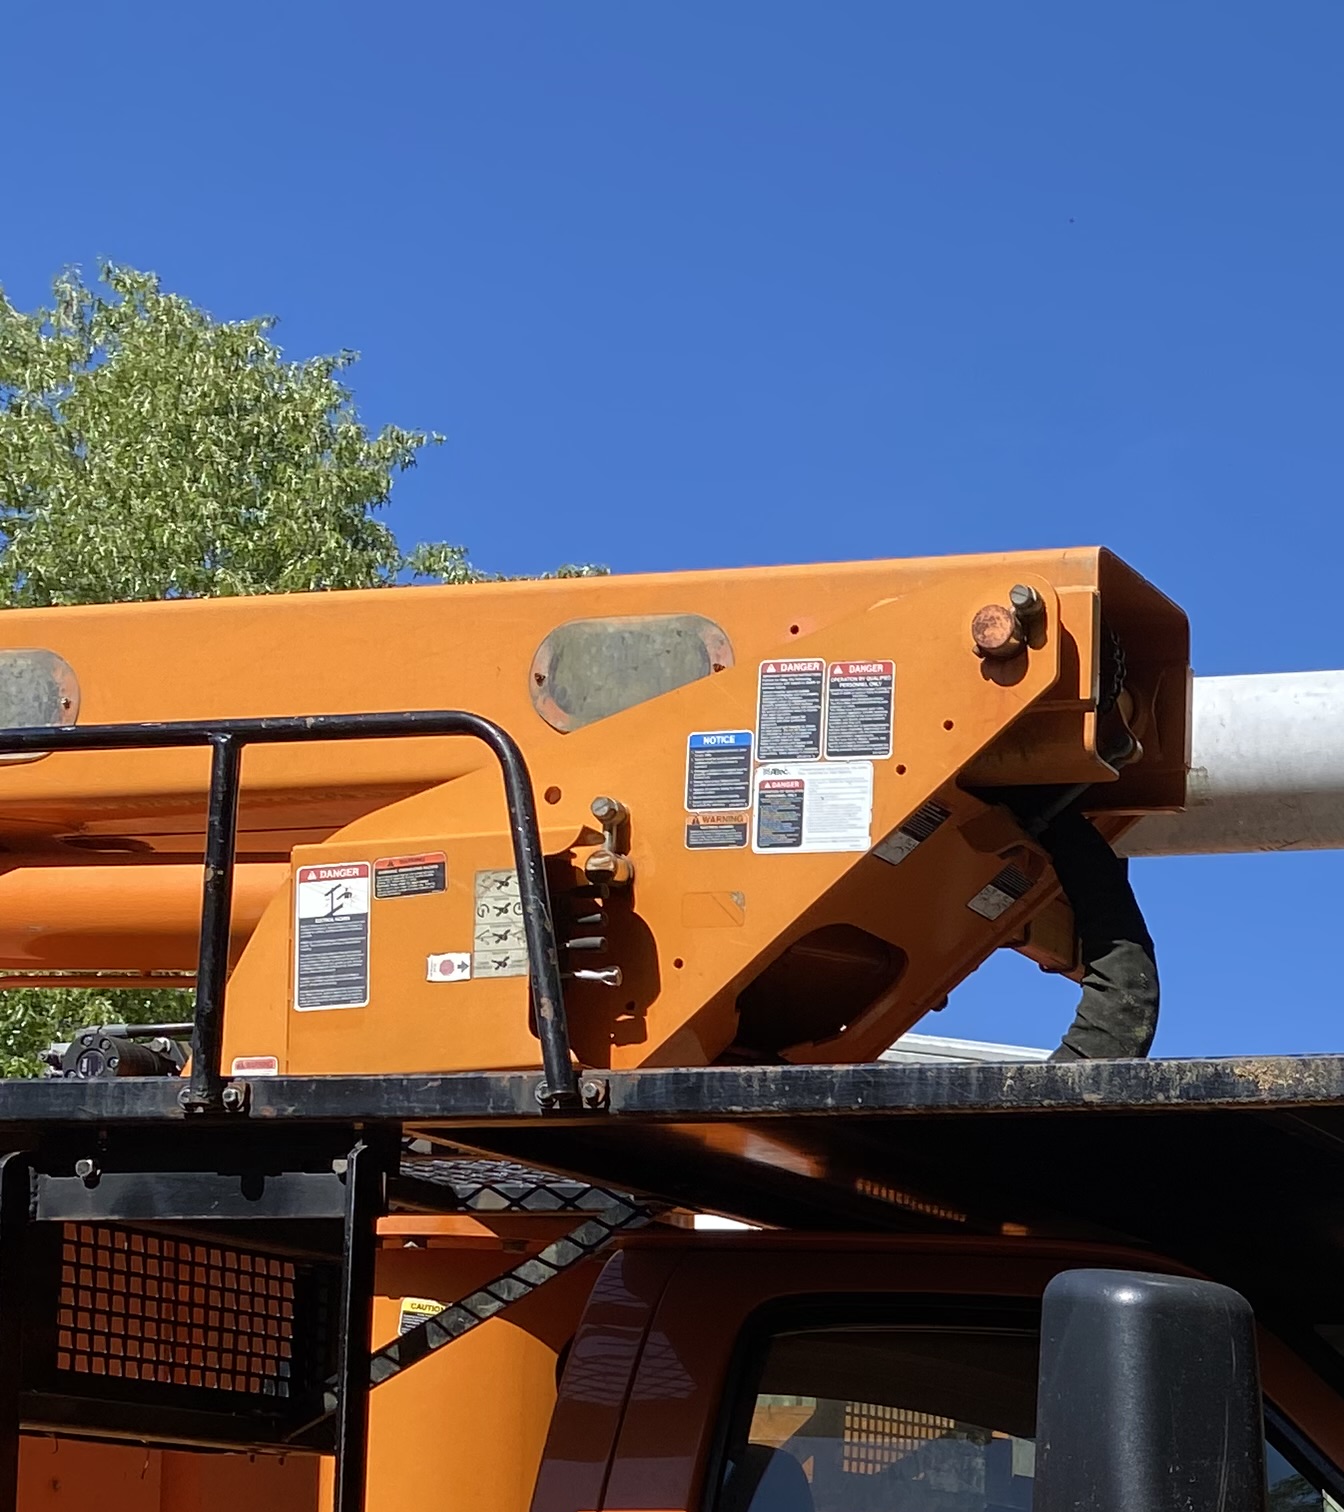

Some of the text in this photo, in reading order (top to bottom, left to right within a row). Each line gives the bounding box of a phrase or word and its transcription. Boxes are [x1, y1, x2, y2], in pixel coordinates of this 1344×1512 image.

[780, 662, 820, 672] DANGER
[848, 664, 884, 673] DANGER
[703, 735, 735, 745] NOTICE
[771, 781, 800, 789] DANGER
[702, 814, 744, 823] WARNING
[319, 867, 359, 879] DANGER
